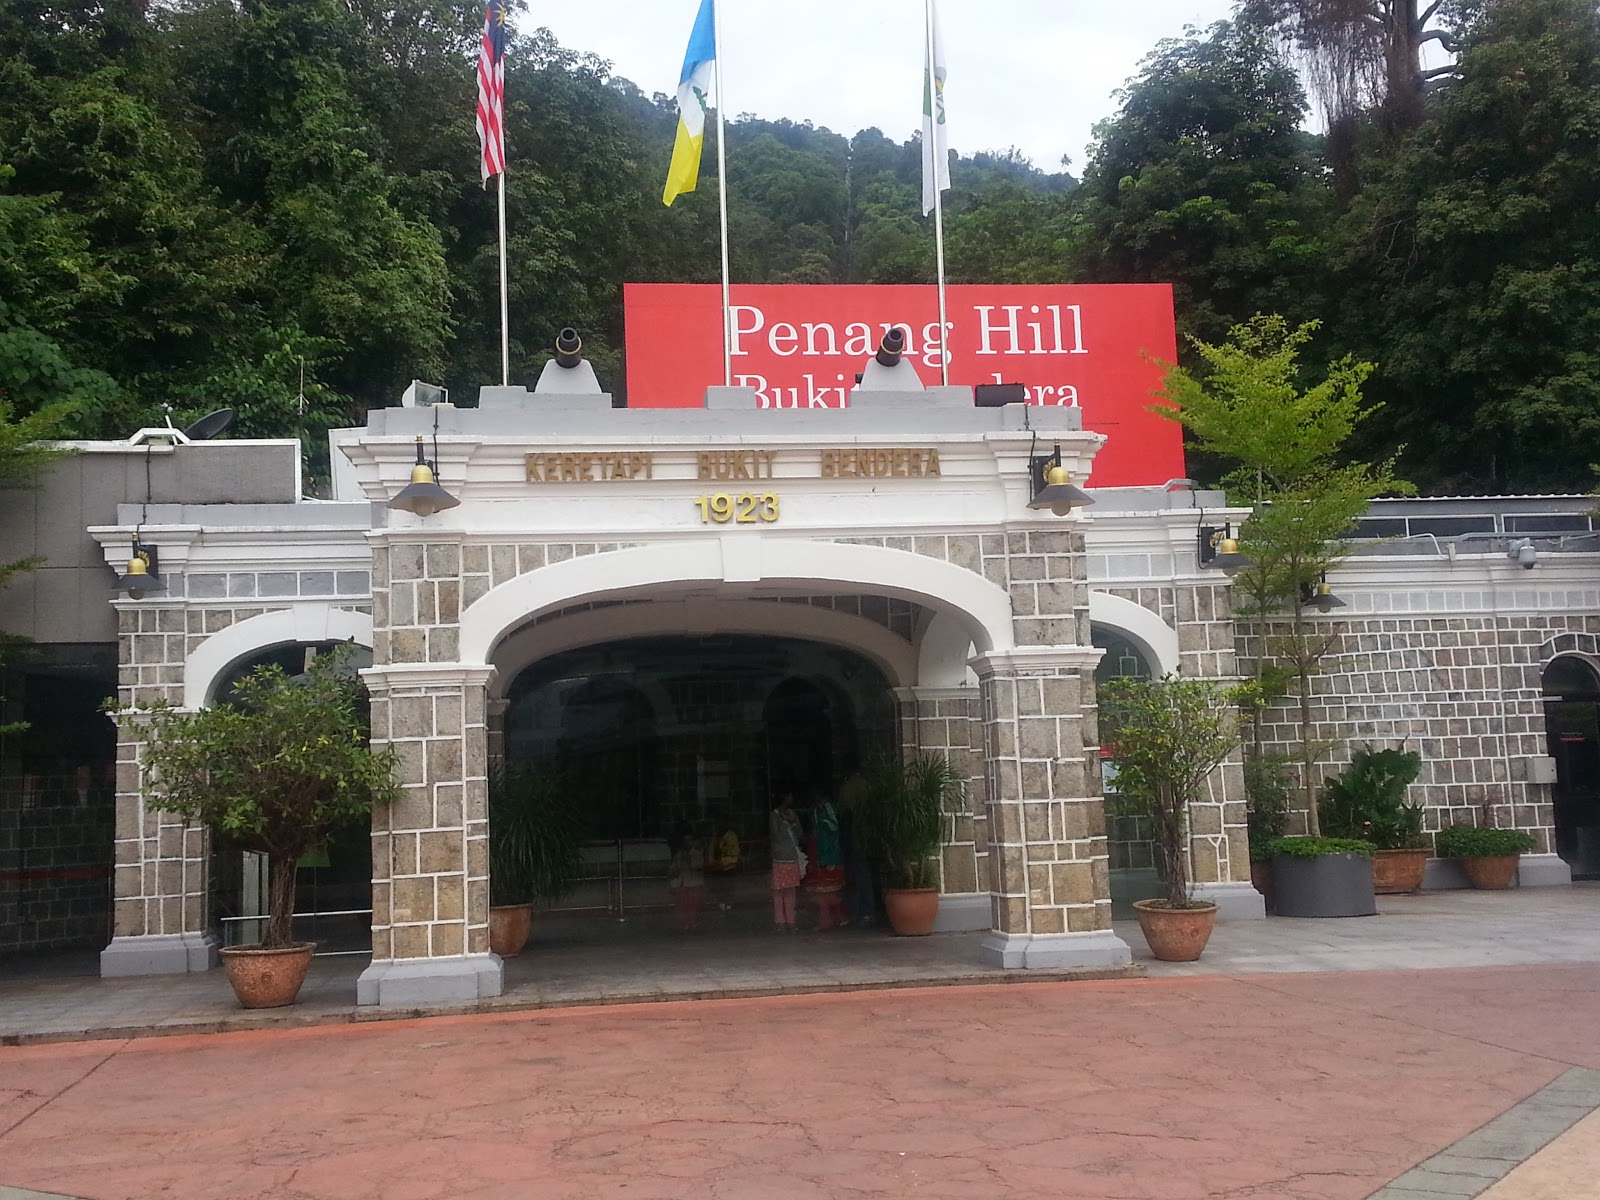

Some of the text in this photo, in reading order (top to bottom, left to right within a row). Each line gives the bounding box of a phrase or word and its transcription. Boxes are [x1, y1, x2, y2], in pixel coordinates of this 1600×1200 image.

[728, 304, 1089, 368] Penang Hill
[733, 373, 859, 408] Buki
[525, 448, 941, 483] KERETAPI BUKIT BENDERA
[695, 491, 781, 523] 1923
